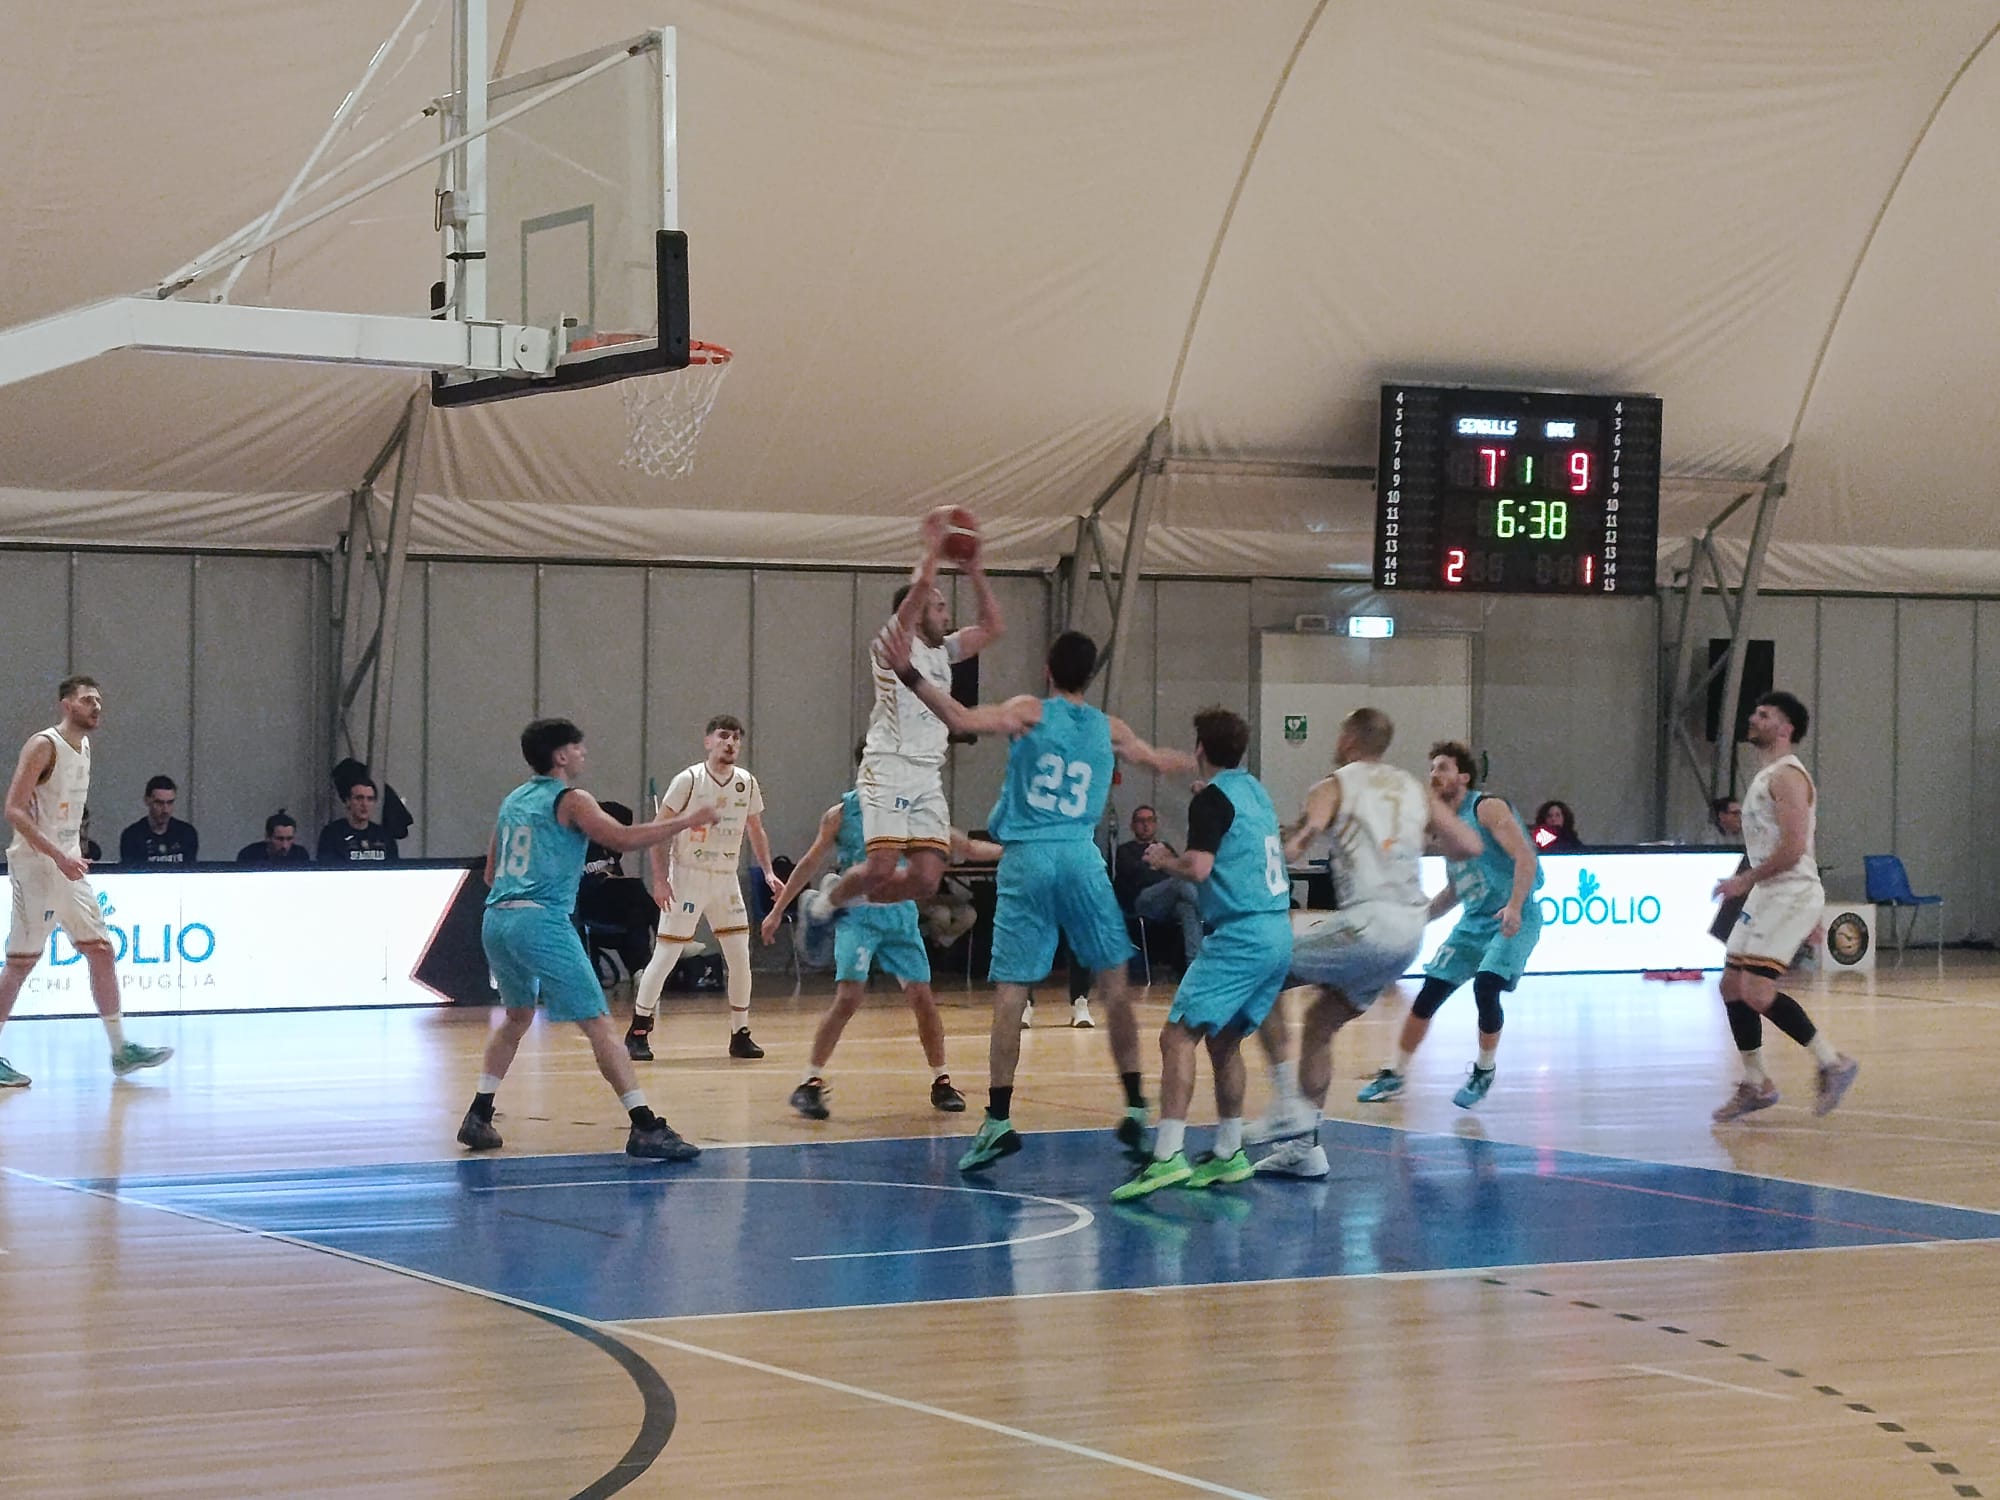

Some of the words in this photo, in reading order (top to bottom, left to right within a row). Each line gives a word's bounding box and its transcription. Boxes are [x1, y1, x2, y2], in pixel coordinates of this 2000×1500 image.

[1396, 392, 1404, 405] 4
[1395, 408, 1403, 421] 5
[1614, 401, 1622, 415] 4
[1394, 424, 1402, 437] 6
[1614, 417, 1622, 431] 5
[1614, 433, 1621, 446] 6
[1394, 441, 1402, 454] 7
[1613, 449, 1621, 463] 7
[1393, 457, 1401, 471] 8
[1525, 455, 1533, 484] 1
[1570, 452, 1589, 492] 9
[1612, 465, 1620, 479] 8
[1392, 474, 1400, 487] 9
[1612, 481, 1620, 494] 9
[1387, 490, 1400, 504] 10
[1606, 498, 1619, 512] 10
[1386, 507, 1399, 520] 11
[1497, 499, 1567, 540] 6:38
[1605, 514, 1618, 528] 11
[1386, 523, 1399, 536] 12
[1604, 530, 1617, 544] 12
[1385, 539, 1398, 553] 13
[1604, 546, 1617, 559] 13
[1384, 556, 1398, 570] 14
[1447, 550, 1464, 583] 2
[1603, 562, 1617, 576] 14
[1586, 556, 1593, 585] 1
[1383, 572, 1397, 585] 15
[1603, 578, 1616, 592] 15
[1027, 753, 1092, 817] 23
[495, 826, 532, 878] 18
